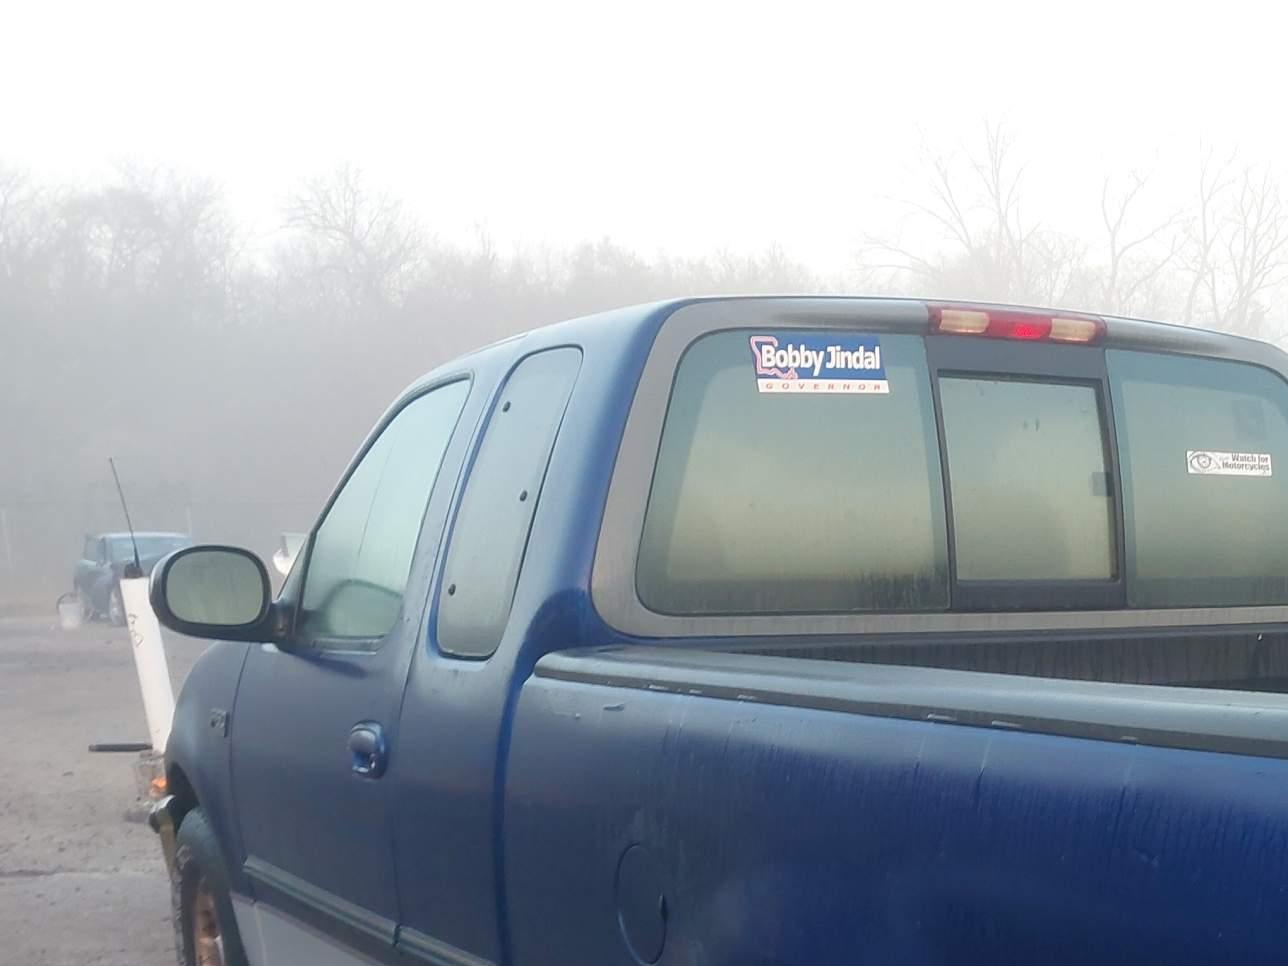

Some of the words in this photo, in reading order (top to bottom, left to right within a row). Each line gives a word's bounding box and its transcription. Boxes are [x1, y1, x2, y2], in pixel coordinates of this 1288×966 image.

[761, 343, 825, 377] Bobby
[825, 344, 881, 370] Jindal
[765, 382, 882, 391] GOVERNOR
[1231, 452, 1257, 463] Watch
[1257, 454, 1269, 464] for
[1222, 461, 1270, 472] Motorcycles
